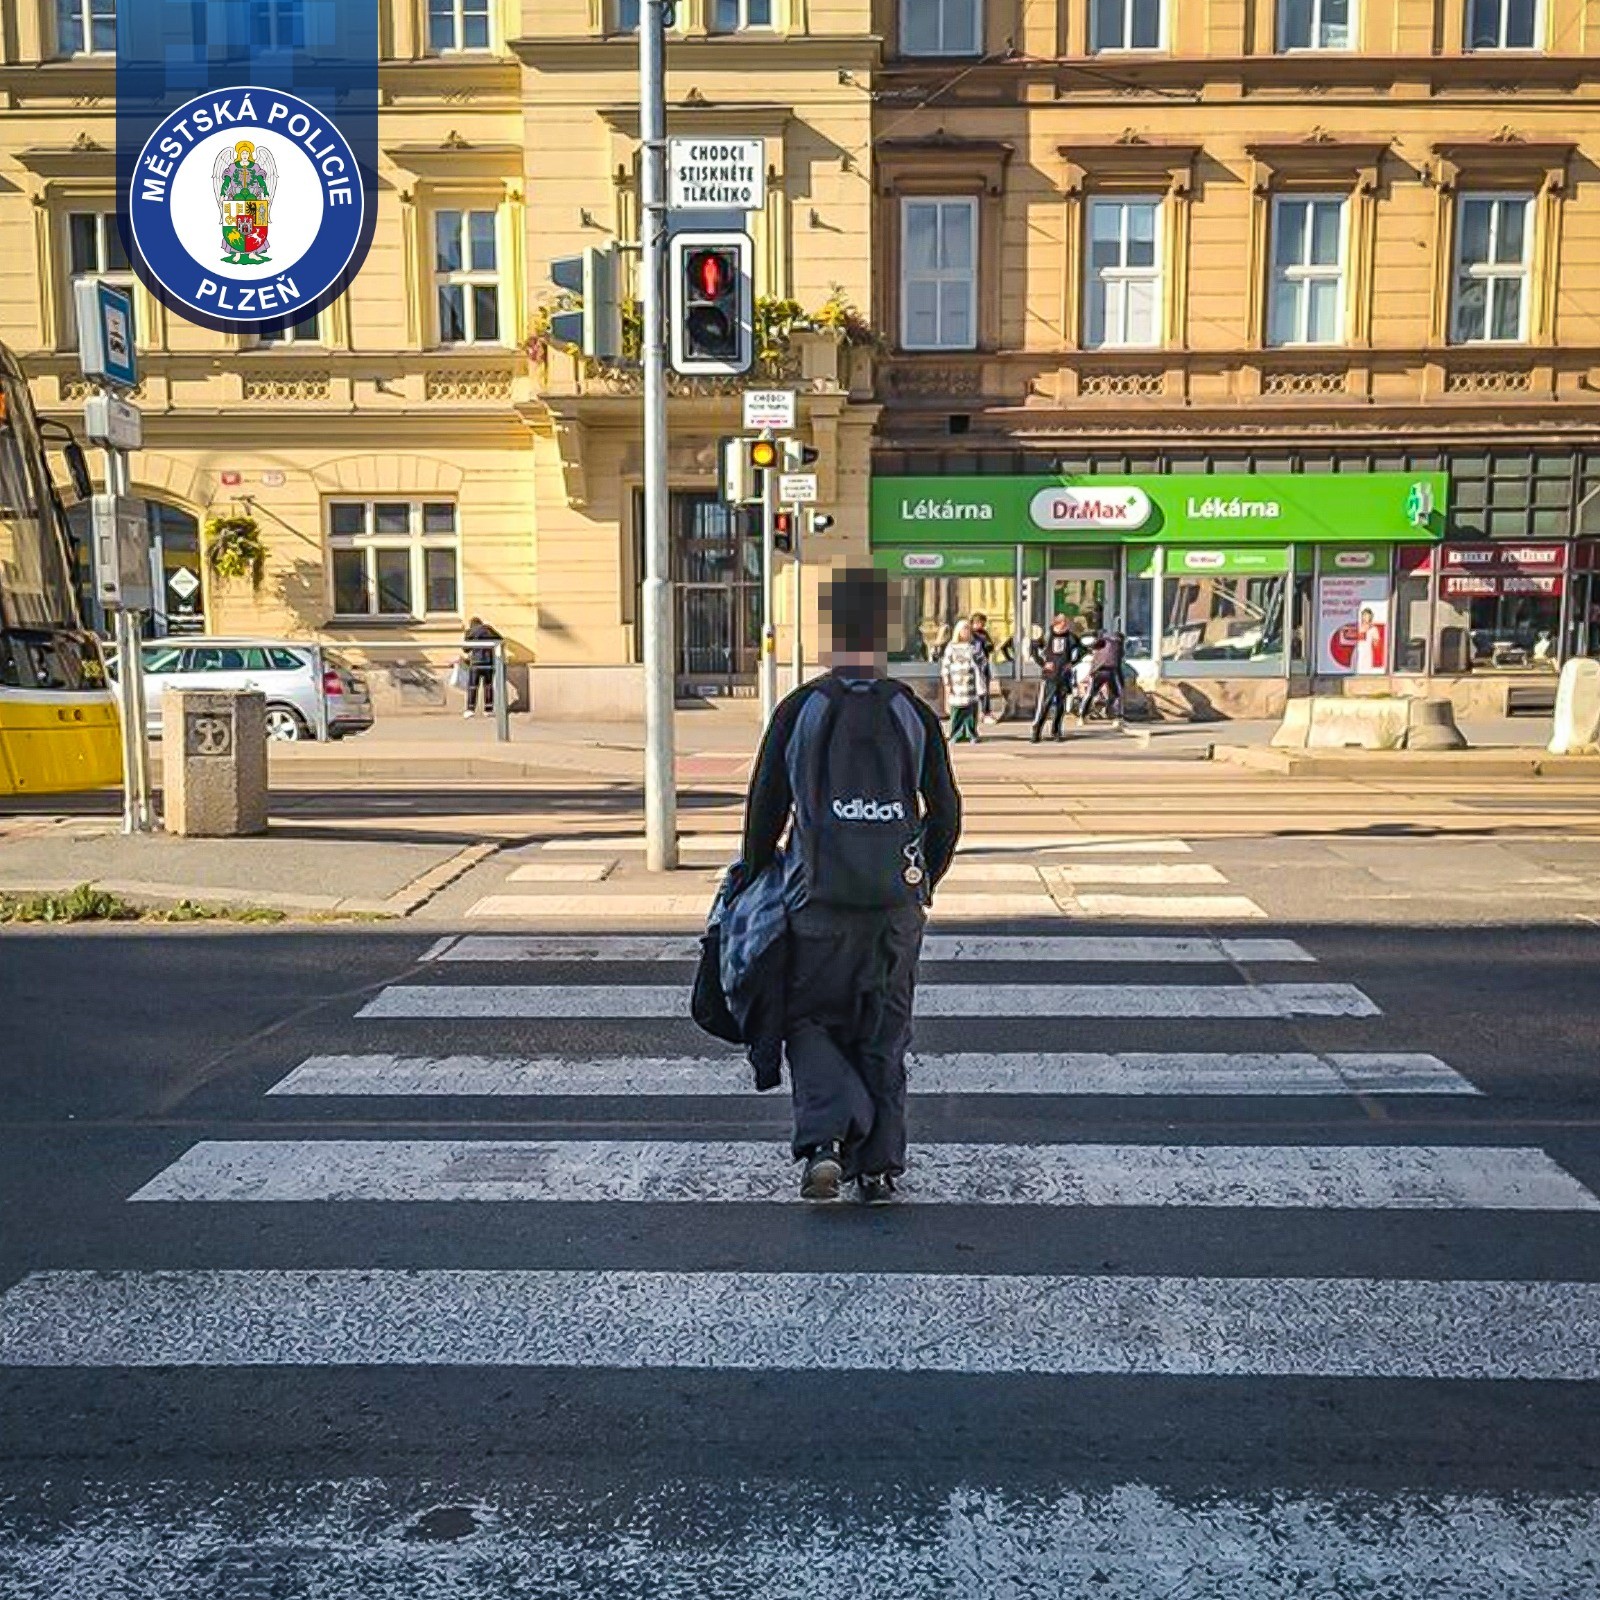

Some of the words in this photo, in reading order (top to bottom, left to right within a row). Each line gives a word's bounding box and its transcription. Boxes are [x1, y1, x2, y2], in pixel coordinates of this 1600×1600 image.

[690, 145, 745, 161] CHODCI
[901, 498, 994, 521] Lékárna
[1053, 500, 1127, 520] Dr.Max
[1187, 496, 1280, 519] Lékárna
